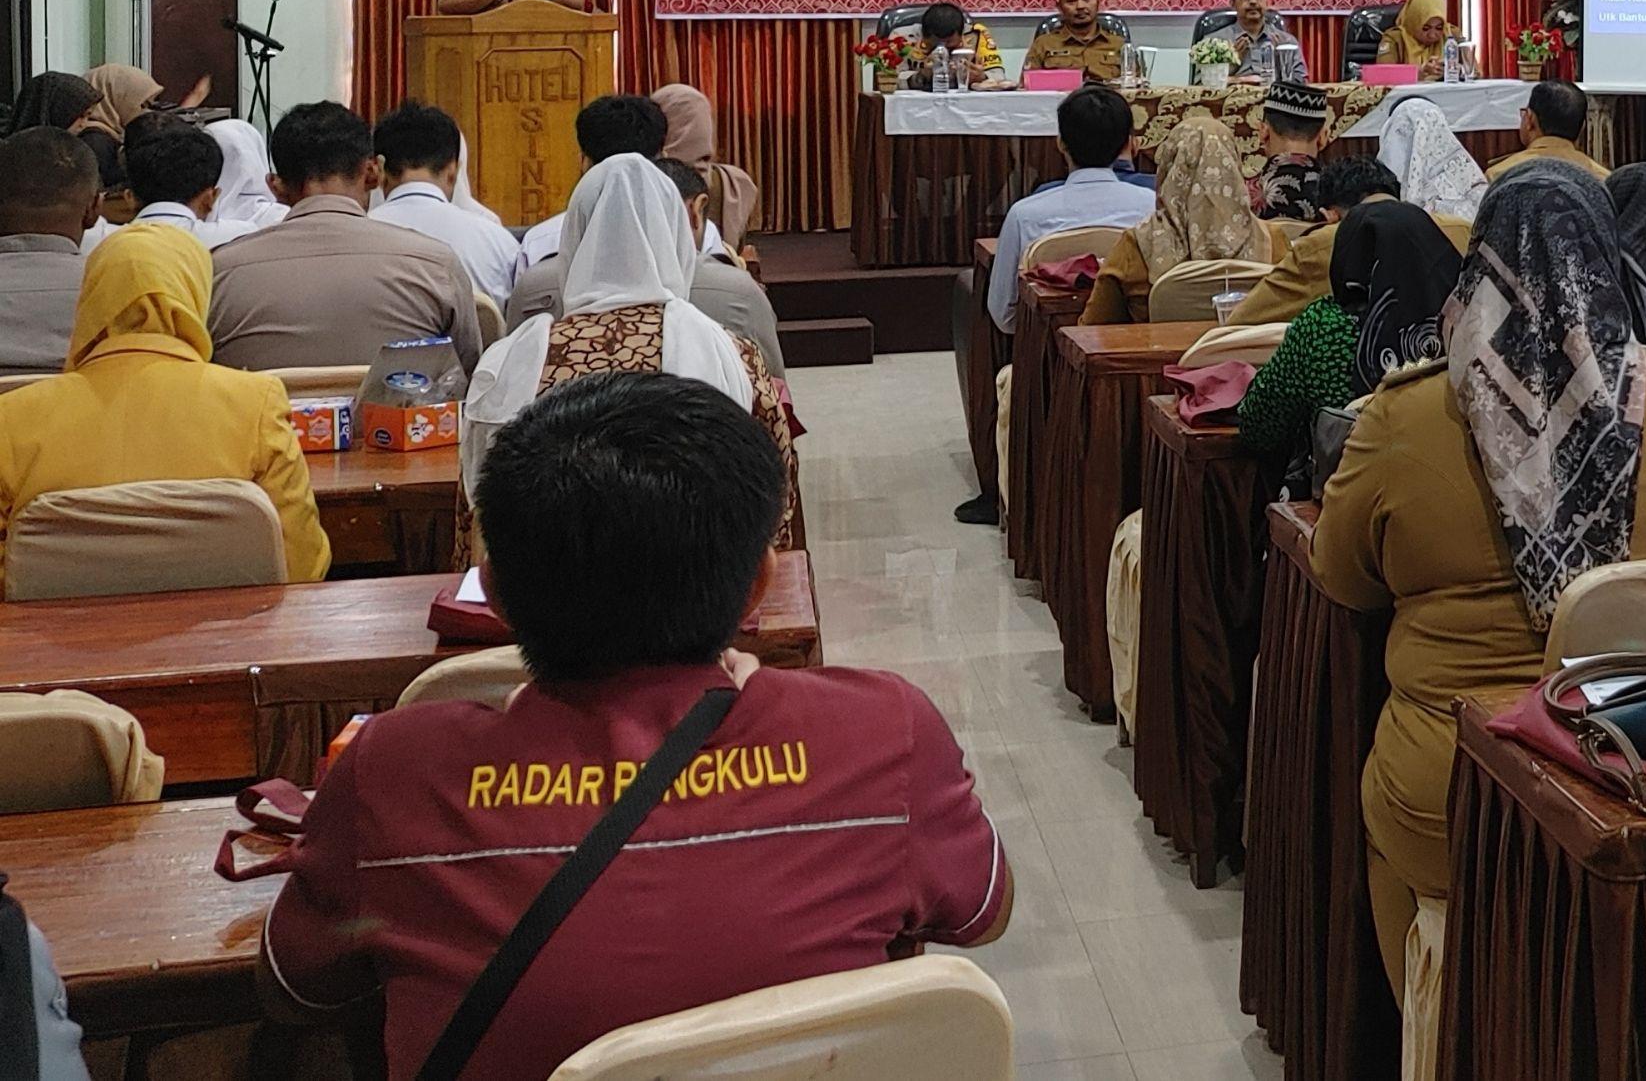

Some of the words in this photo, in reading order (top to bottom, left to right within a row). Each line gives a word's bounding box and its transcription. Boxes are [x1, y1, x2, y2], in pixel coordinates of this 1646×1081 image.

[1598, 12, 1616, 22] Utk
[484, 62, 579, 104] HOTEL
[467, 763, 605, 808] RADAR
[613, 741, 808, 804] BNGKULU
